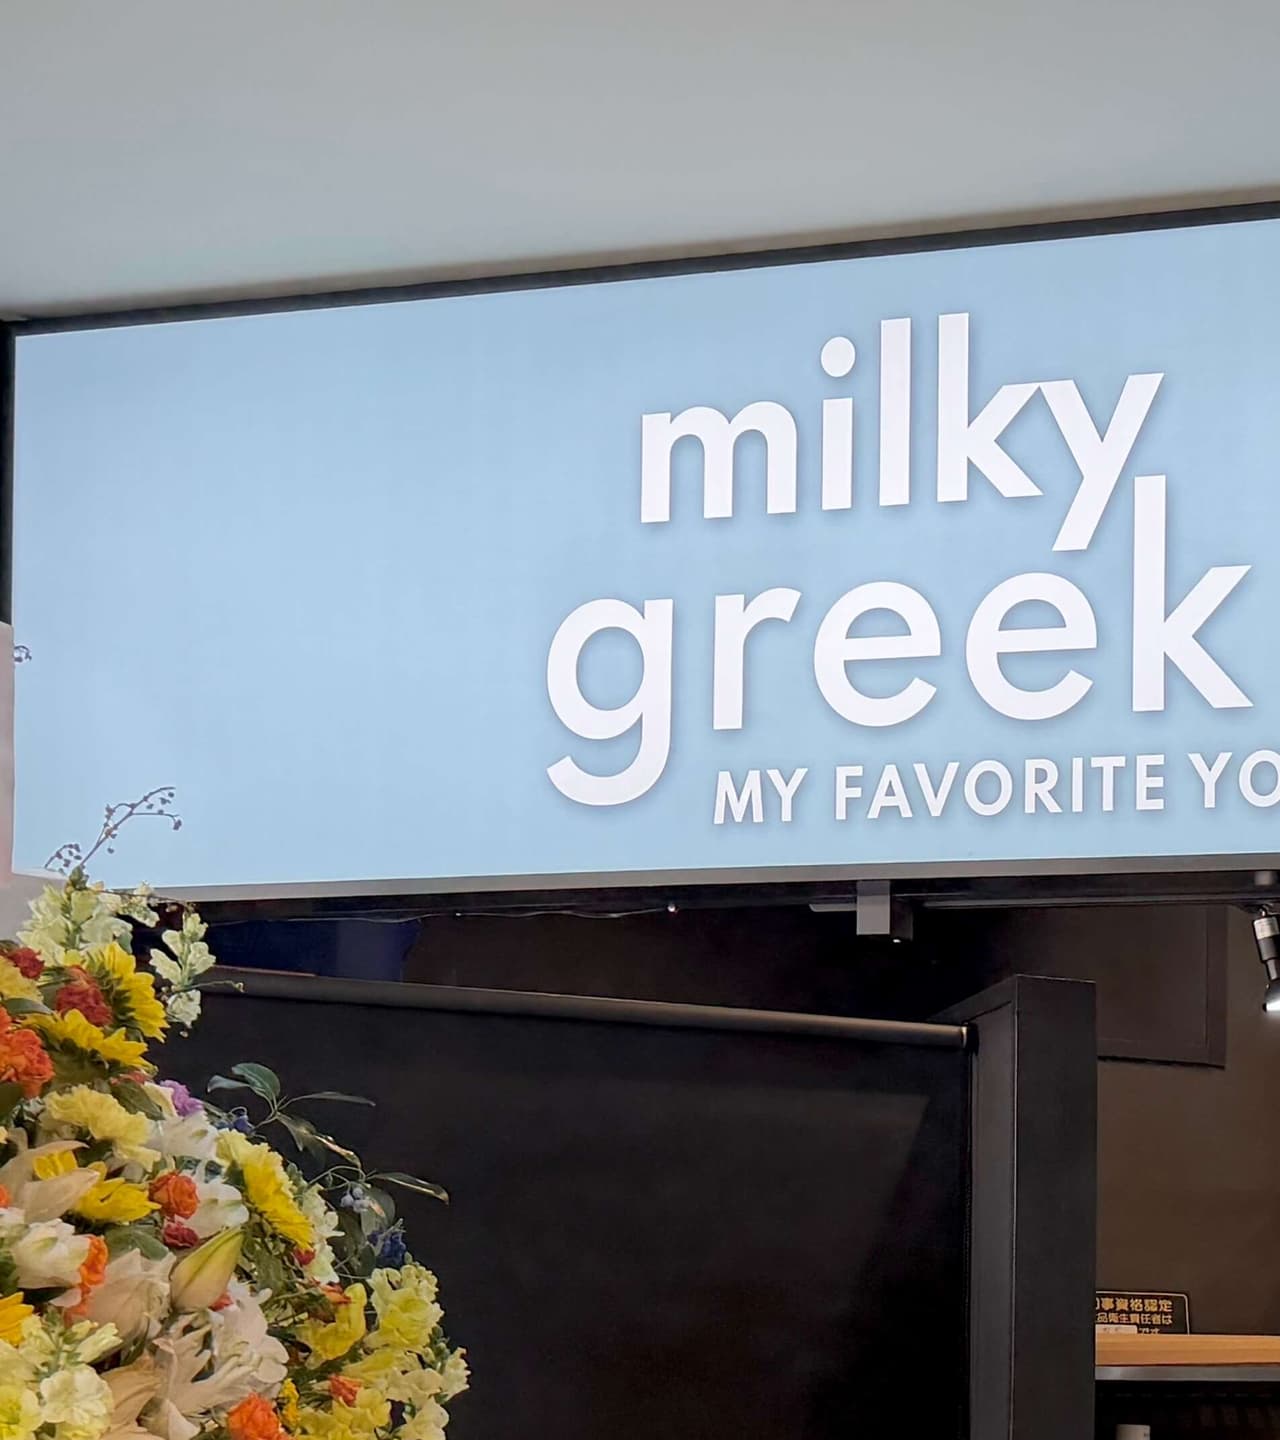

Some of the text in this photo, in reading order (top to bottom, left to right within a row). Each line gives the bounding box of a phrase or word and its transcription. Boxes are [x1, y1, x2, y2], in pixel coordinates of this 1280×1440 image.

[638, 311, 1166, 552] milky
[545, 473, 1254, 807] greek
[712, 768, 808, 825] MY
[833, 752, 1165, 821] FAVORITE
[1096, 1312, 1173, 1325] 品衛生責任者は
